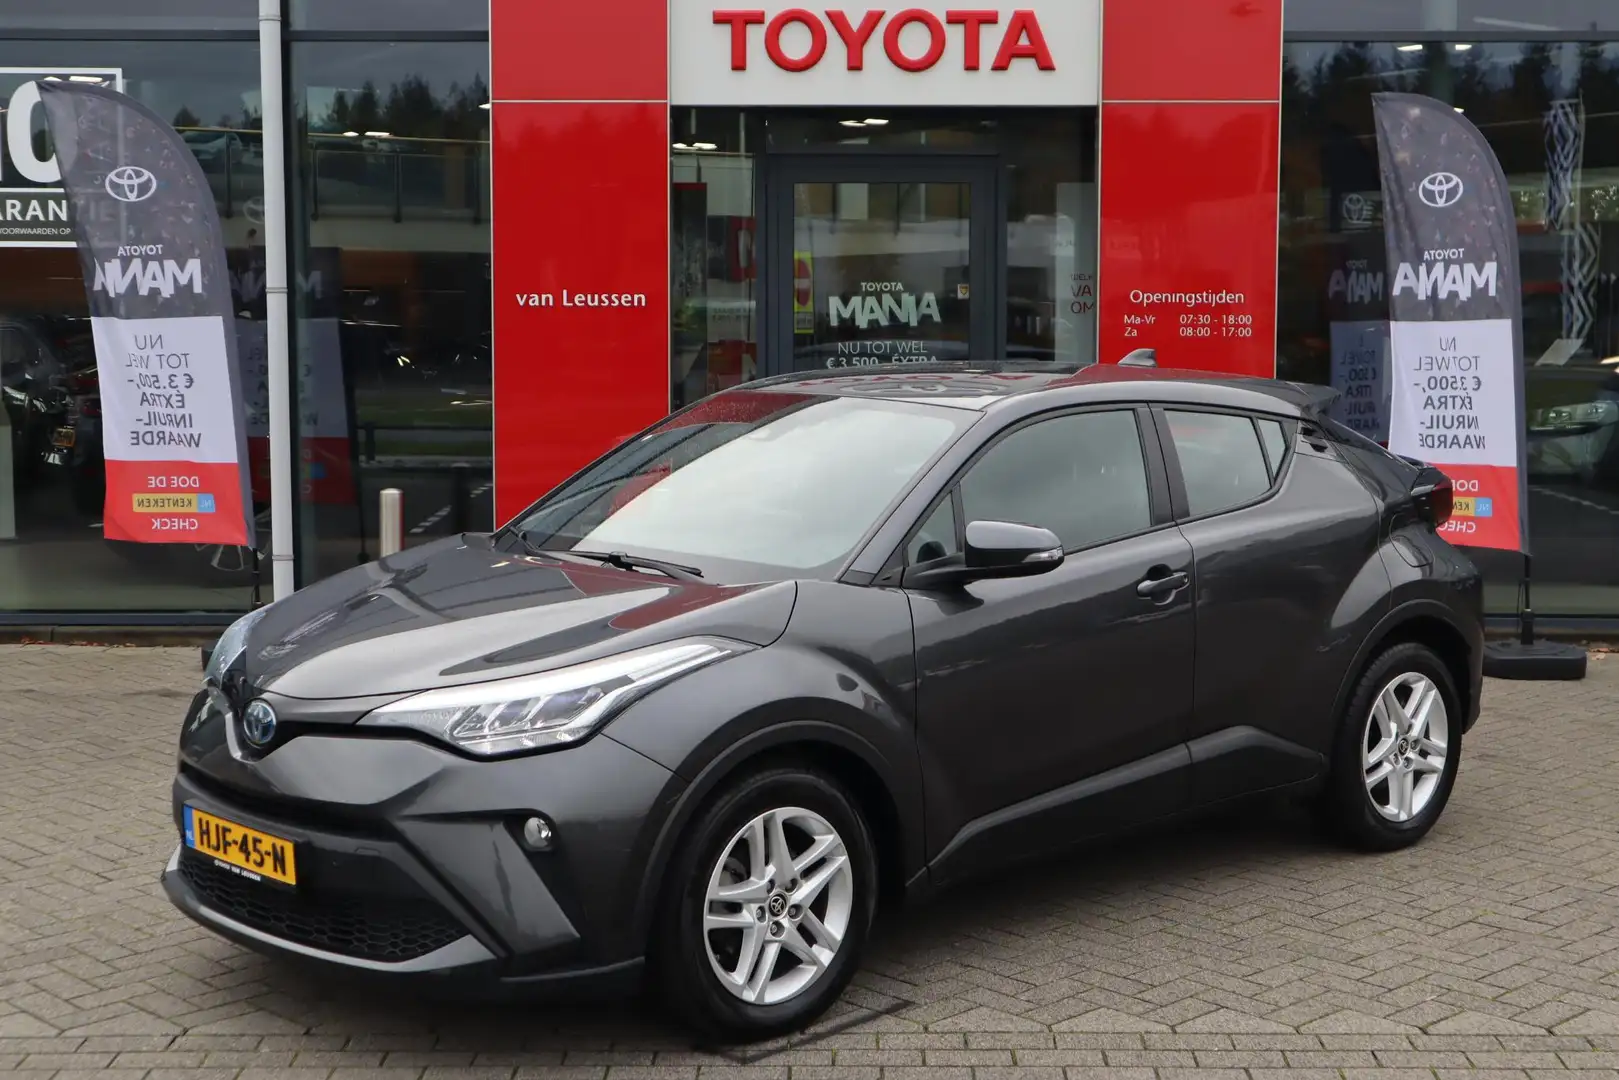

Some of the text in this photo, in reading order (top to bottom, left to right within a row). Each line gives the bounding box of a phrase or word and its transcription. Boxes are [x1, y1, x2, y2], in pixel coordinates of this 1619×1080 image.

[712, 8, 1056, 73] TOYOTA
[0, 199, 68, 222] RAN
[861, 282, 904, 291] TOYOTA
[515, 289, 646, 307] van Leussen
[1129, 289, 1245, 307] Openingstijden
[828, 292, 941, 329] MANIA
[1124, 314, 1156, 325] Ma-Vr
[1179, 314, 1211, 325] 07:30
[1222, 314, 1252, 325] 18:00
[1124, 326, 1138, 337] Za
[1179, 327, 1211, 337] 08:00
[1222, 327, 1252, 337] 17:00
[838, 340, 928, 354] NU TOT WEL
[198, 817, 287, 877] HJF-45-N
